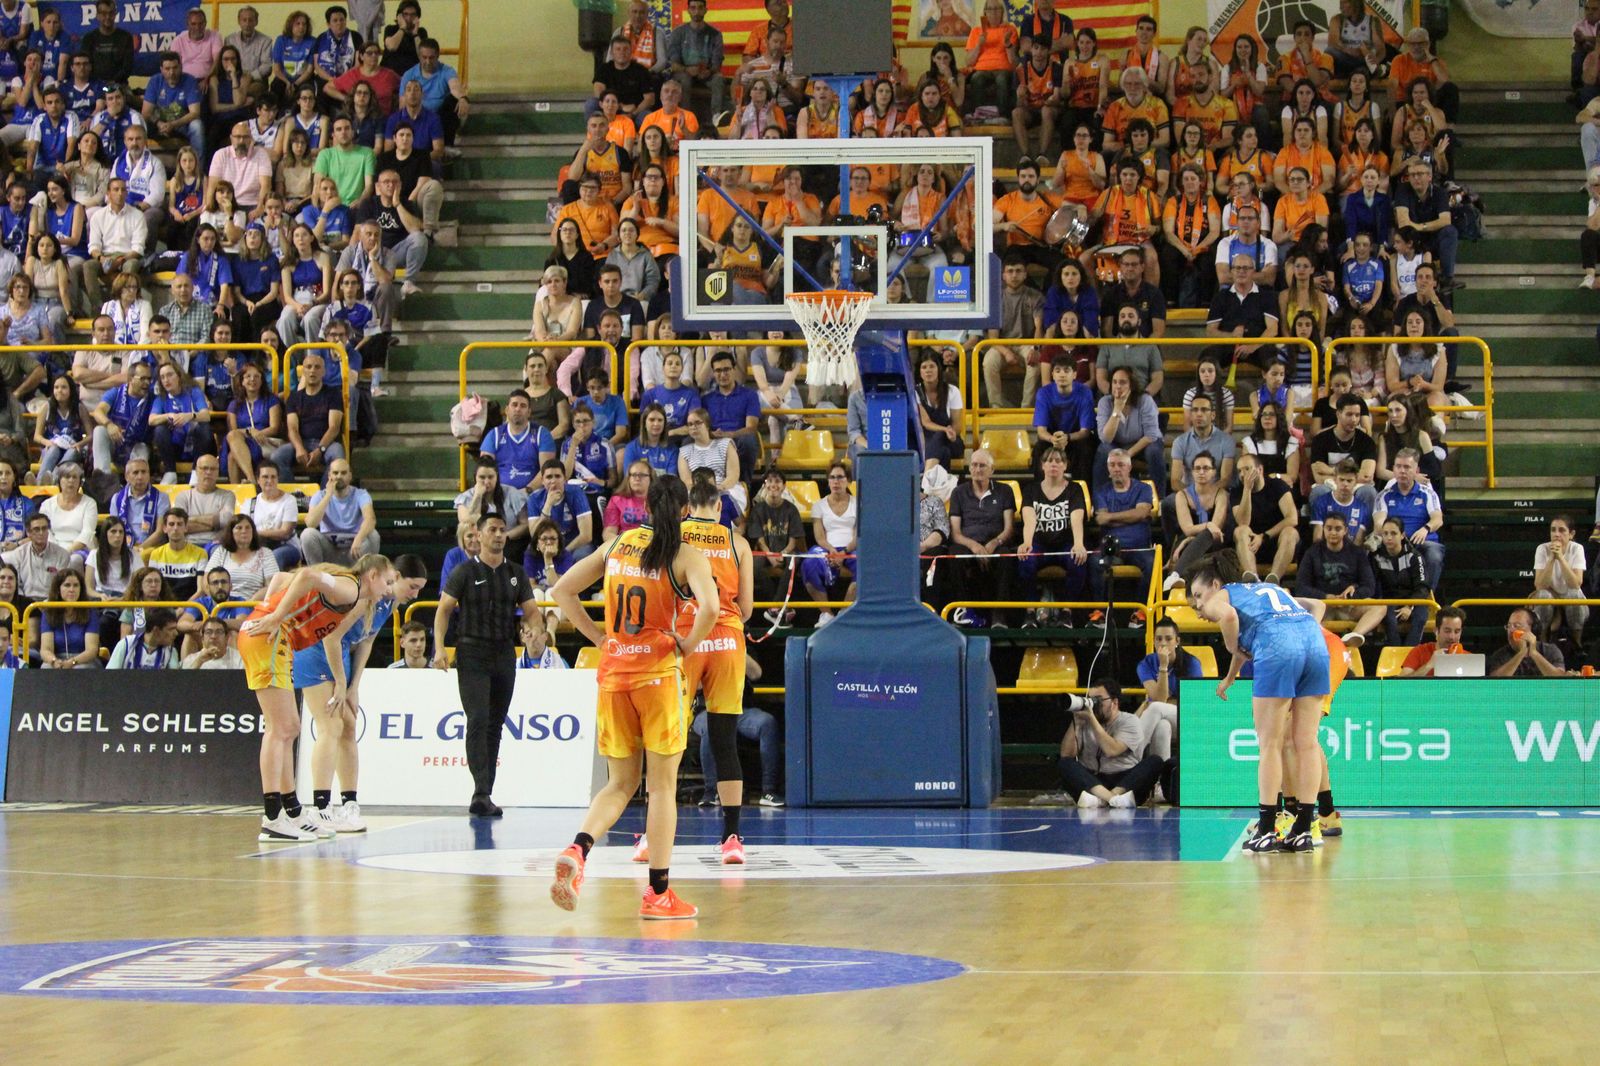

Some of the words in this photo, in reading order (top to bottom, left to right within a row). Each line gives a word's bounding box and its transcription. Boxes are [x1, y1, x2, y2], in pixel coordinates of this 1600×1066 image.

[881, 409, 892, 451] MONDO
[683, 531, 726, 545] CARRERA
[613, 583, 647, 635] 10
[836, 682, 880, 693] CASTILLA
[884, 685, 891, 694] Y
[893, 684, 918, 694] LEÓN
[17, 712, 110, 733] ANGEL
[122, 713, 267, 734] SCHLESSE
[379, 713, 423, 740] EL
[436, 711, 581, 741] GNSO
[102, 743, 207, 753] PARFUMS
[423, 756, 501, 767] PERFUS
[914, 781, 956, 791] MONDO
